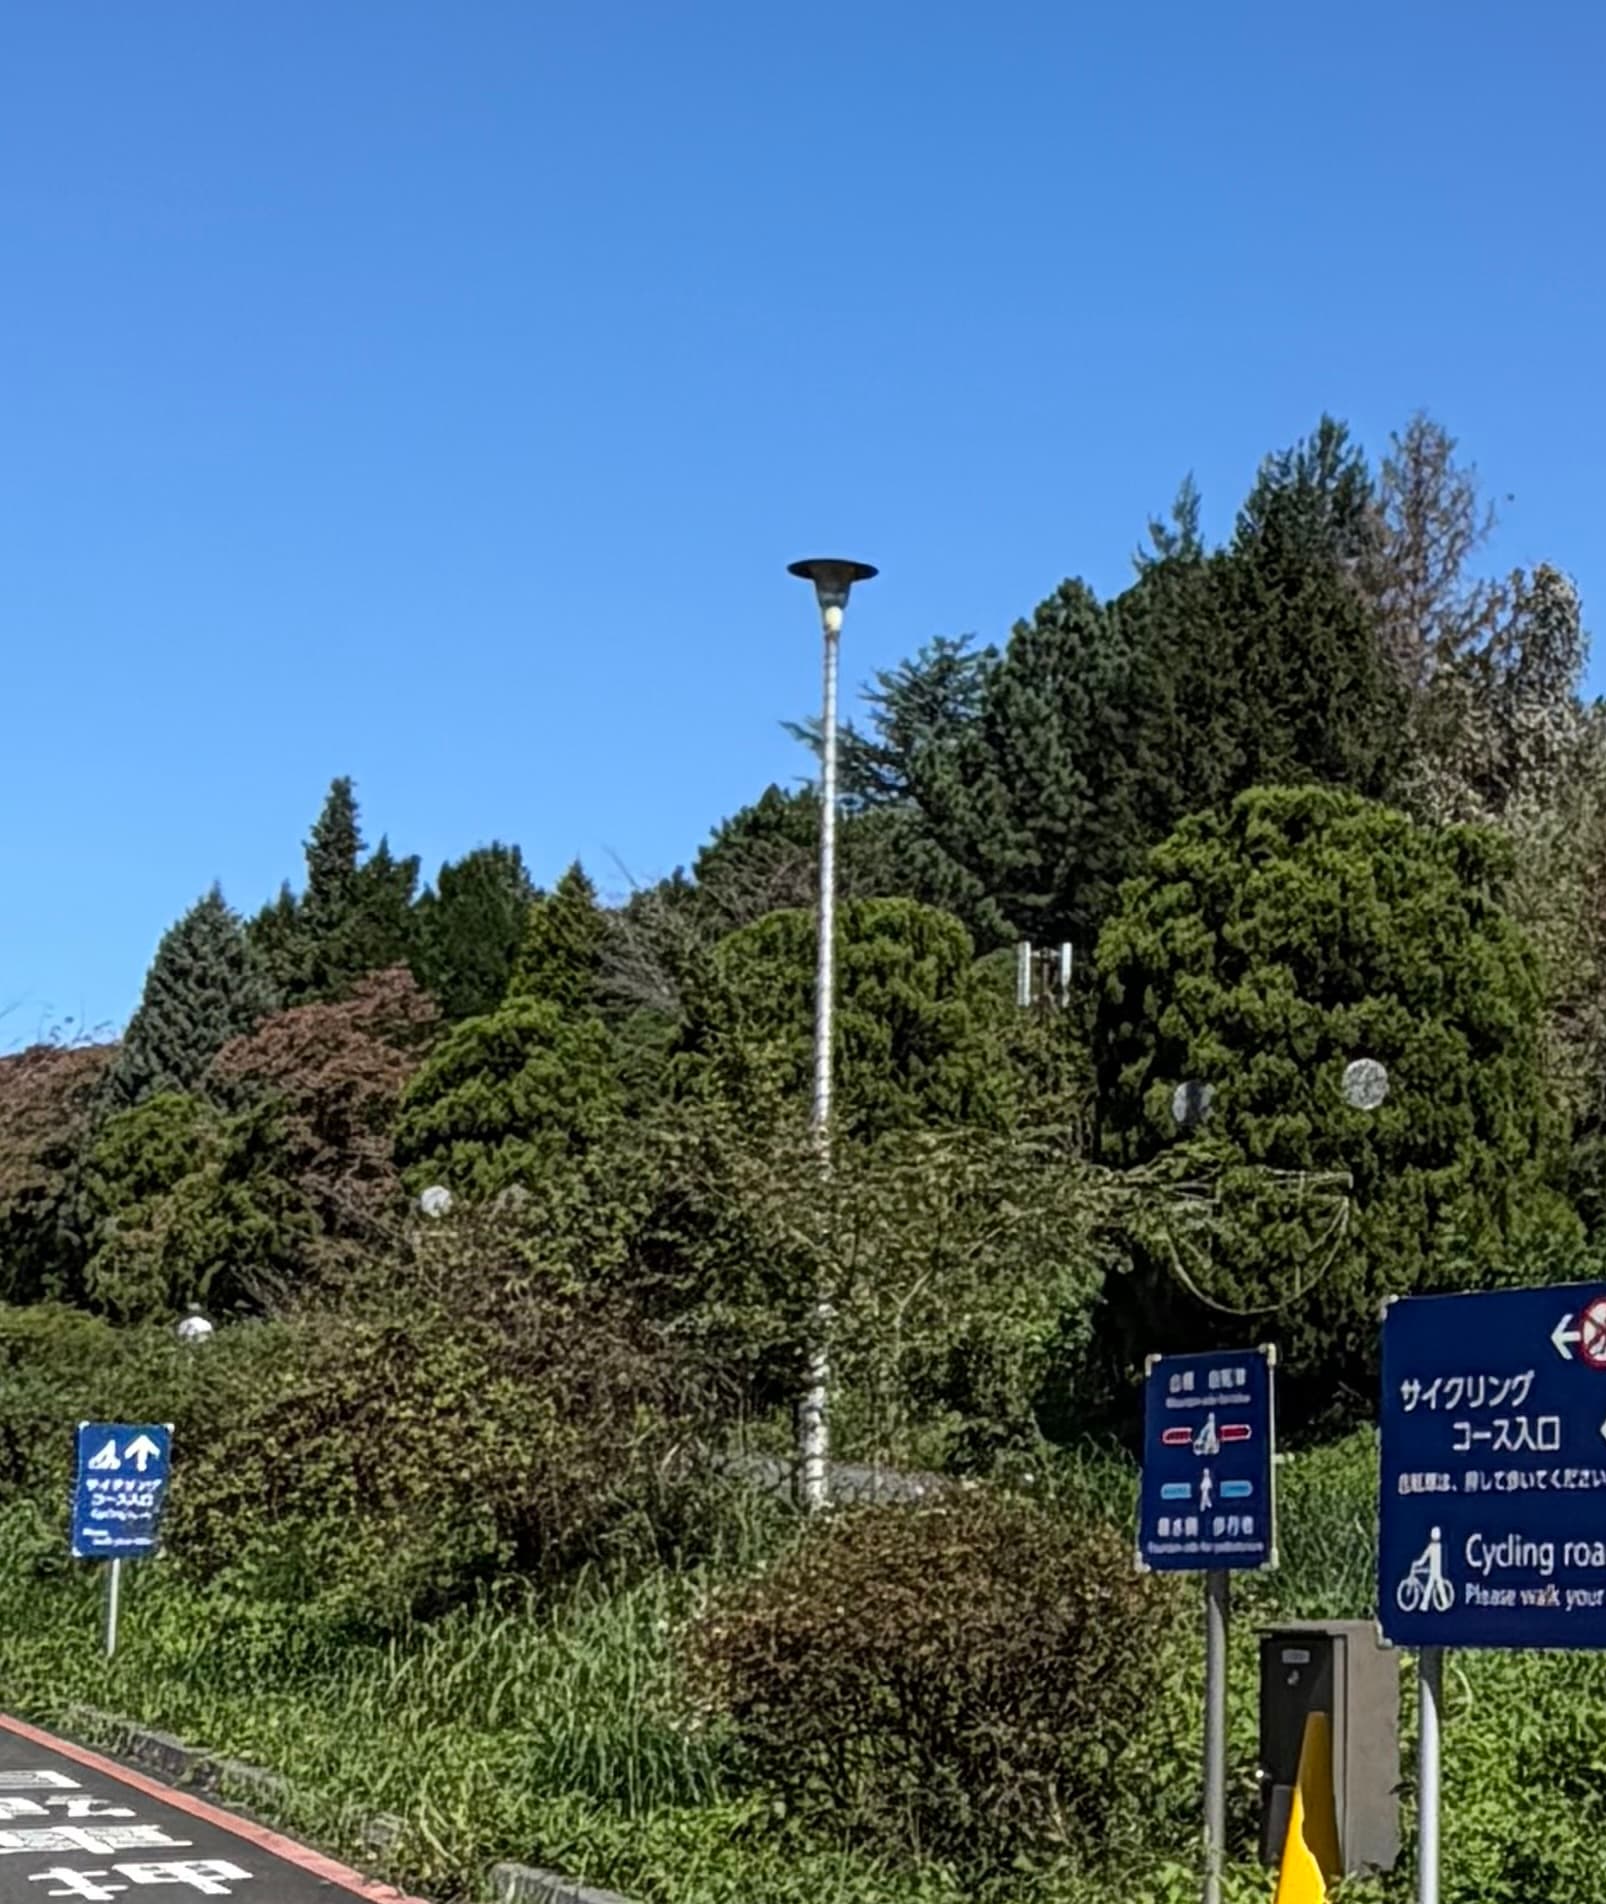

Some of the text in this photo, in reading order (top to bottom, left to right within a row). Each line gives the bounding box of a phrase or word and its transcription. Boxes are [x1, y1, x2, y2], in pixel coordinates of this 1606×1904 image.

[1399, 1369, 1536, 1412] サイクリング
[1451, 1415, 1561, 1453] コース入口
[1465, 1532, 1555, 1576] Cycling
[1465, 1581, 1516, 1606] Please
[1519, 1583, 1561, 1607] walk
[1565, 1588, 1605, 1612] your
